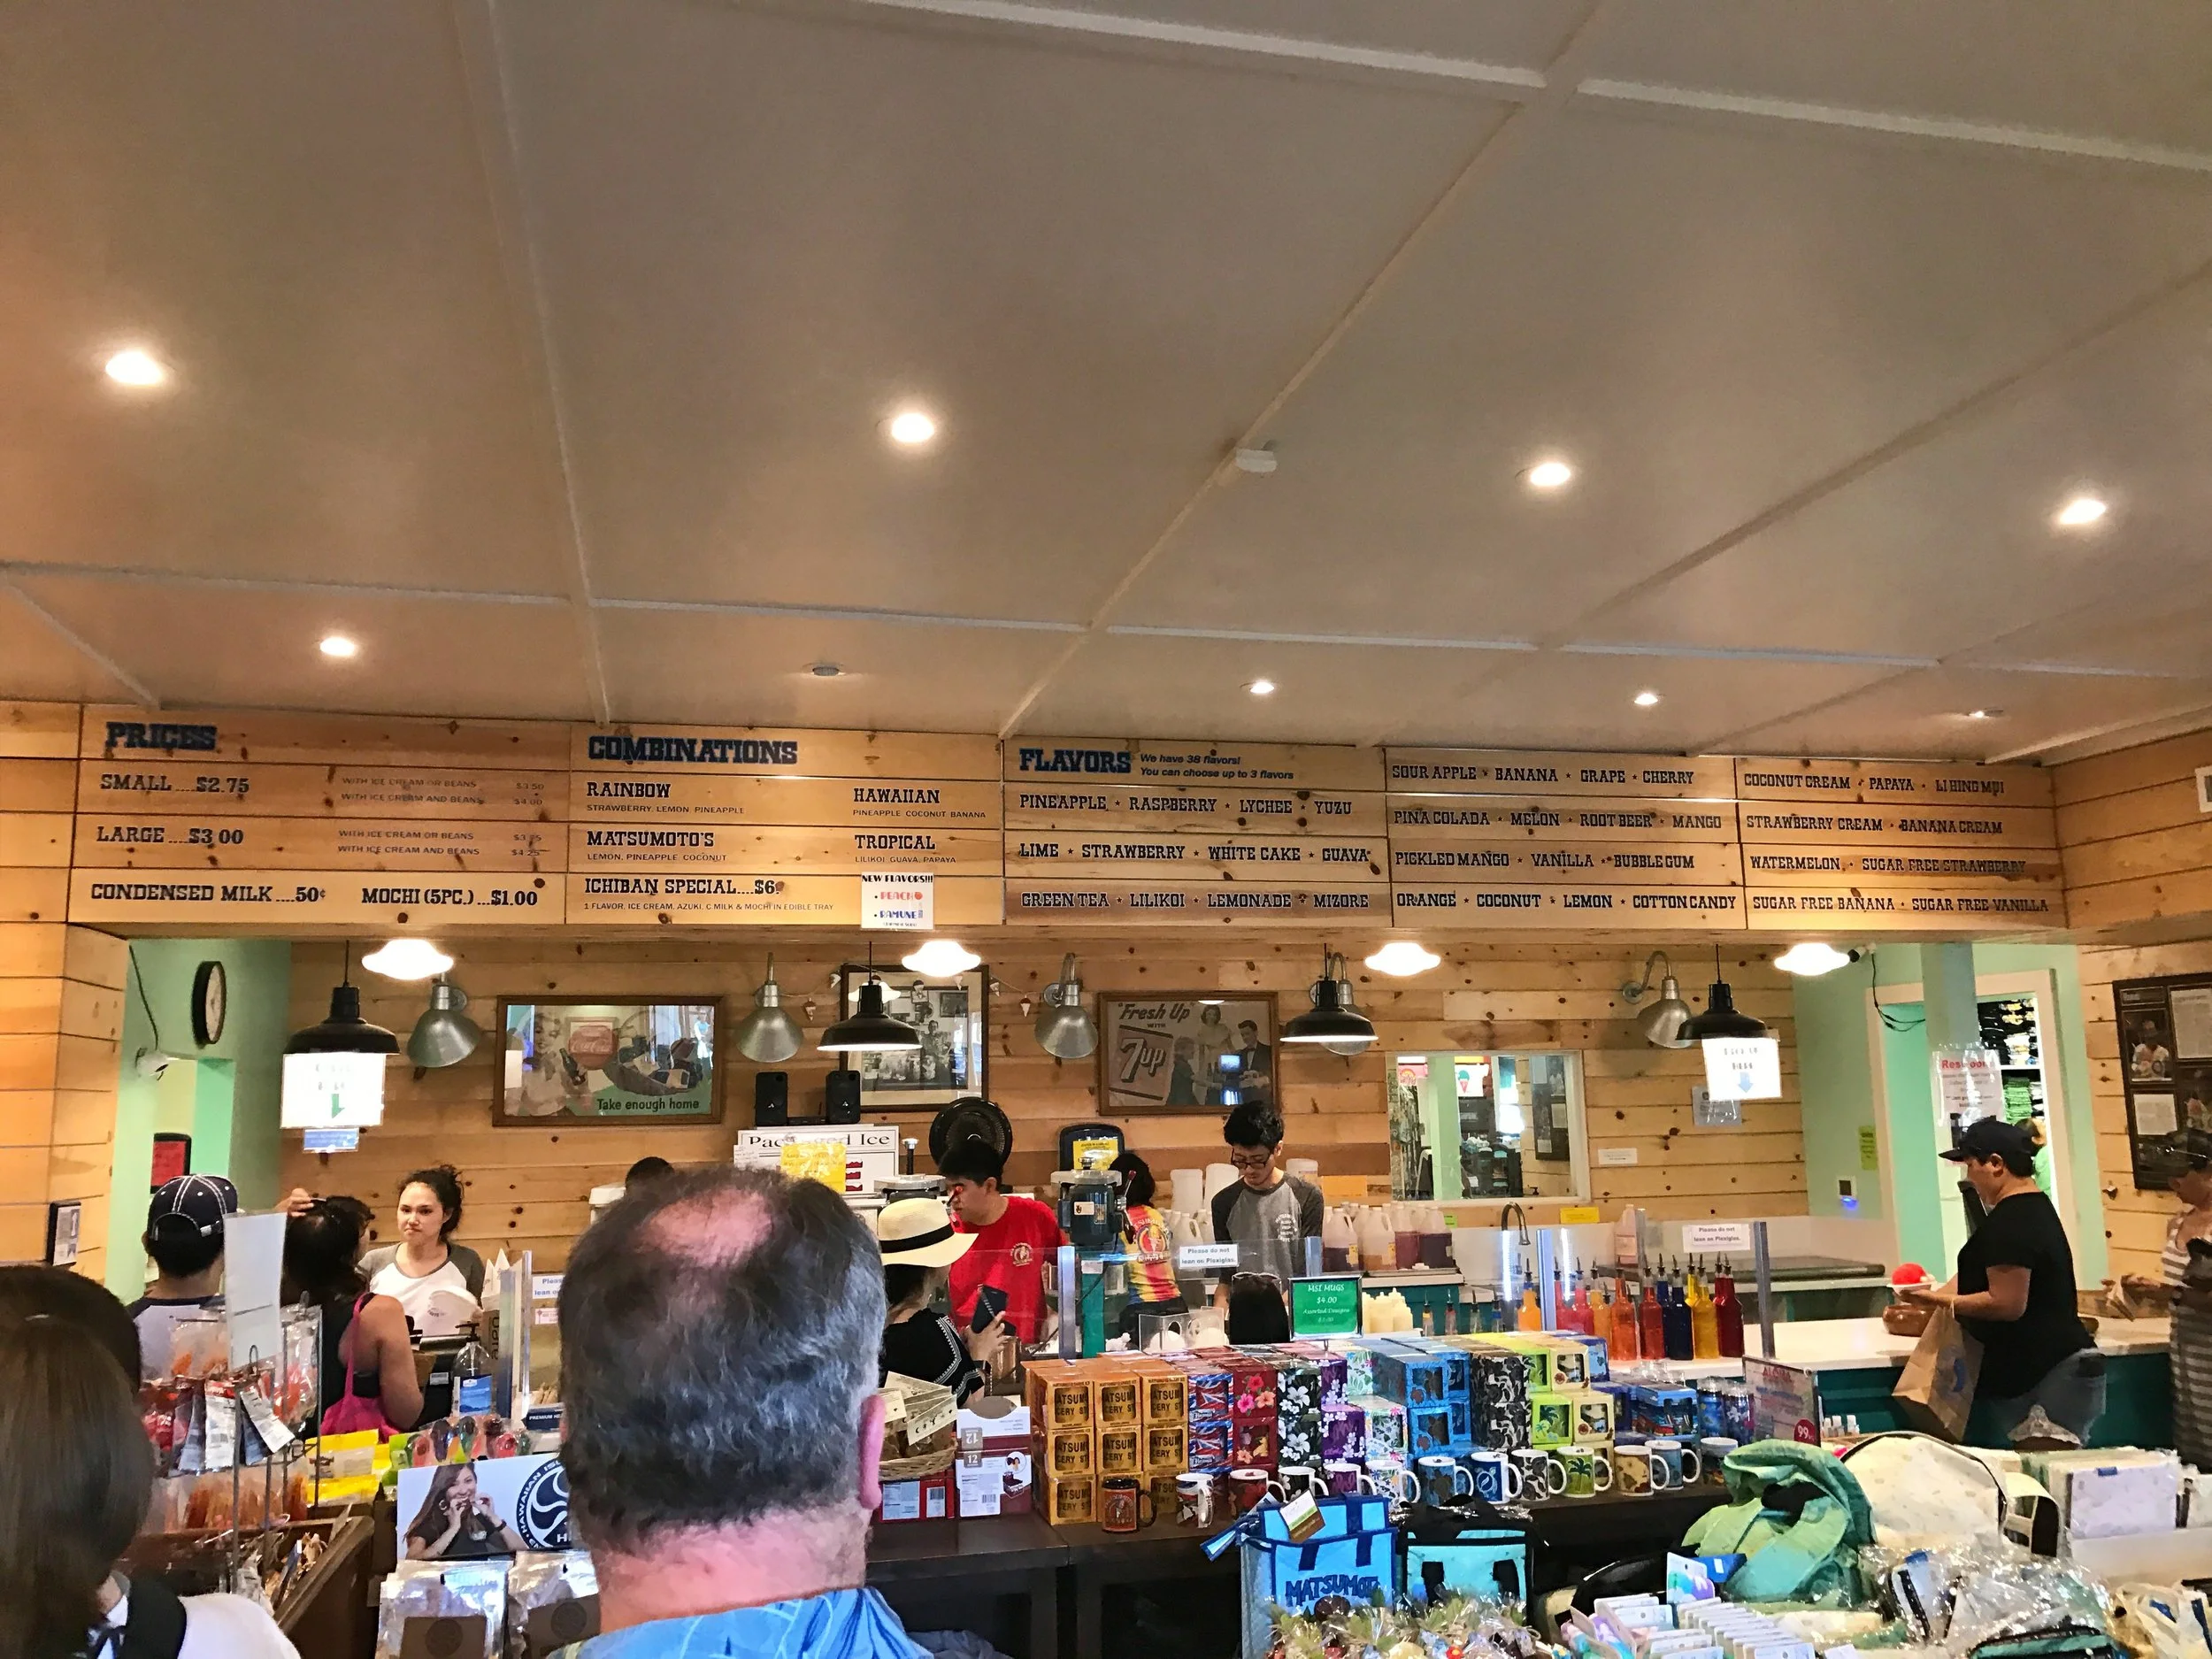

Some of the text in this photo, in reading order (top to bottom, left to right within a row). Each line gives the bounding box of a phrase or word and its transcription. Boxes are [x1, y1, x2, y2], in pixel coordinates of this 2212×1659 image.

[106, 721, 217, 750] PRICES
[588, 736, 798, 764] COMBINATIONS
[1019, 748, 1131, 773] FLAVORS
[1140, 754, 1240, 764] We have 38 flavors!
[1141, 768, 1159, 776] You
[1183, 768, 1219, 777] choose
[1222, 770, 1235, 779] up
[1260, 770, 1294, 779] flavors
[1393, 765, 1694, 784] SOUR APPLE BANANA GRAPE CHERRY
[100, 774, 172, 791] SMALL
[587, 782, 671, 798] RAINBOW
[1744, 773, 2004, 793] COCONUT CREAM PAPAYA HING MUI
[854, 788, 940, 803] HAWAIIAN
[1020, 794, 1352, 814] PINEAPPLE RASPBERRY LYCHEE YUZU
[1433, 811, 1490, 825] COLADA
[1510, 813, 1559, 826] MELON
[1580, 814, 1616, 827] ROOT
[1619, 814, 1652, 828] BEER
[1673, 815, 1721, 829] MANGO
[1747, 815, 2003, 833] STRAWBERRY CREAM BANANA CREAM
[96, 826, 165, 843] LARGE
[587, 831, 714, 847] MATSUMOTO'S
[854, 835, 936, 850] TROPICAL
[1020, 843, 1369, 862] LIME STRAWBERRY WHITE CAKE GUAVA
[1395, 852, 1694, 868] PICKLED MANGO VANILLA BUBBLE GUM
[1750, 856, 2026, 873] WATERMELON SUGAR FREE STRAWBERRY
[91, 883, 273, 902] CONDENSED MILK
[585, 878, 659, 895] ICHIBAN
[362, 888, 474, 905] MOCHI (5PC.)
[880, 891, 913, 900] PEACH
[1022, 893, 1368, 907] GREEN TEA LILIKOI LEMONADE MIZORE
[1397, 893, 1736, 909] ORANGE COCONUT LEMON COTTON CANDY
[1753, 897, 2049, 912] SUGAR FREE BANANA SUGAR FREE VANILLA
[880, 910, 917, 918] RAMUNE
[597, 1097, 699, 1112] Take enough home
[861, 1133, 890, 1145] Ice
[968, 1454, 978, 1464] 12
[518, 1471, 541, 1533] HAWAIIAN
